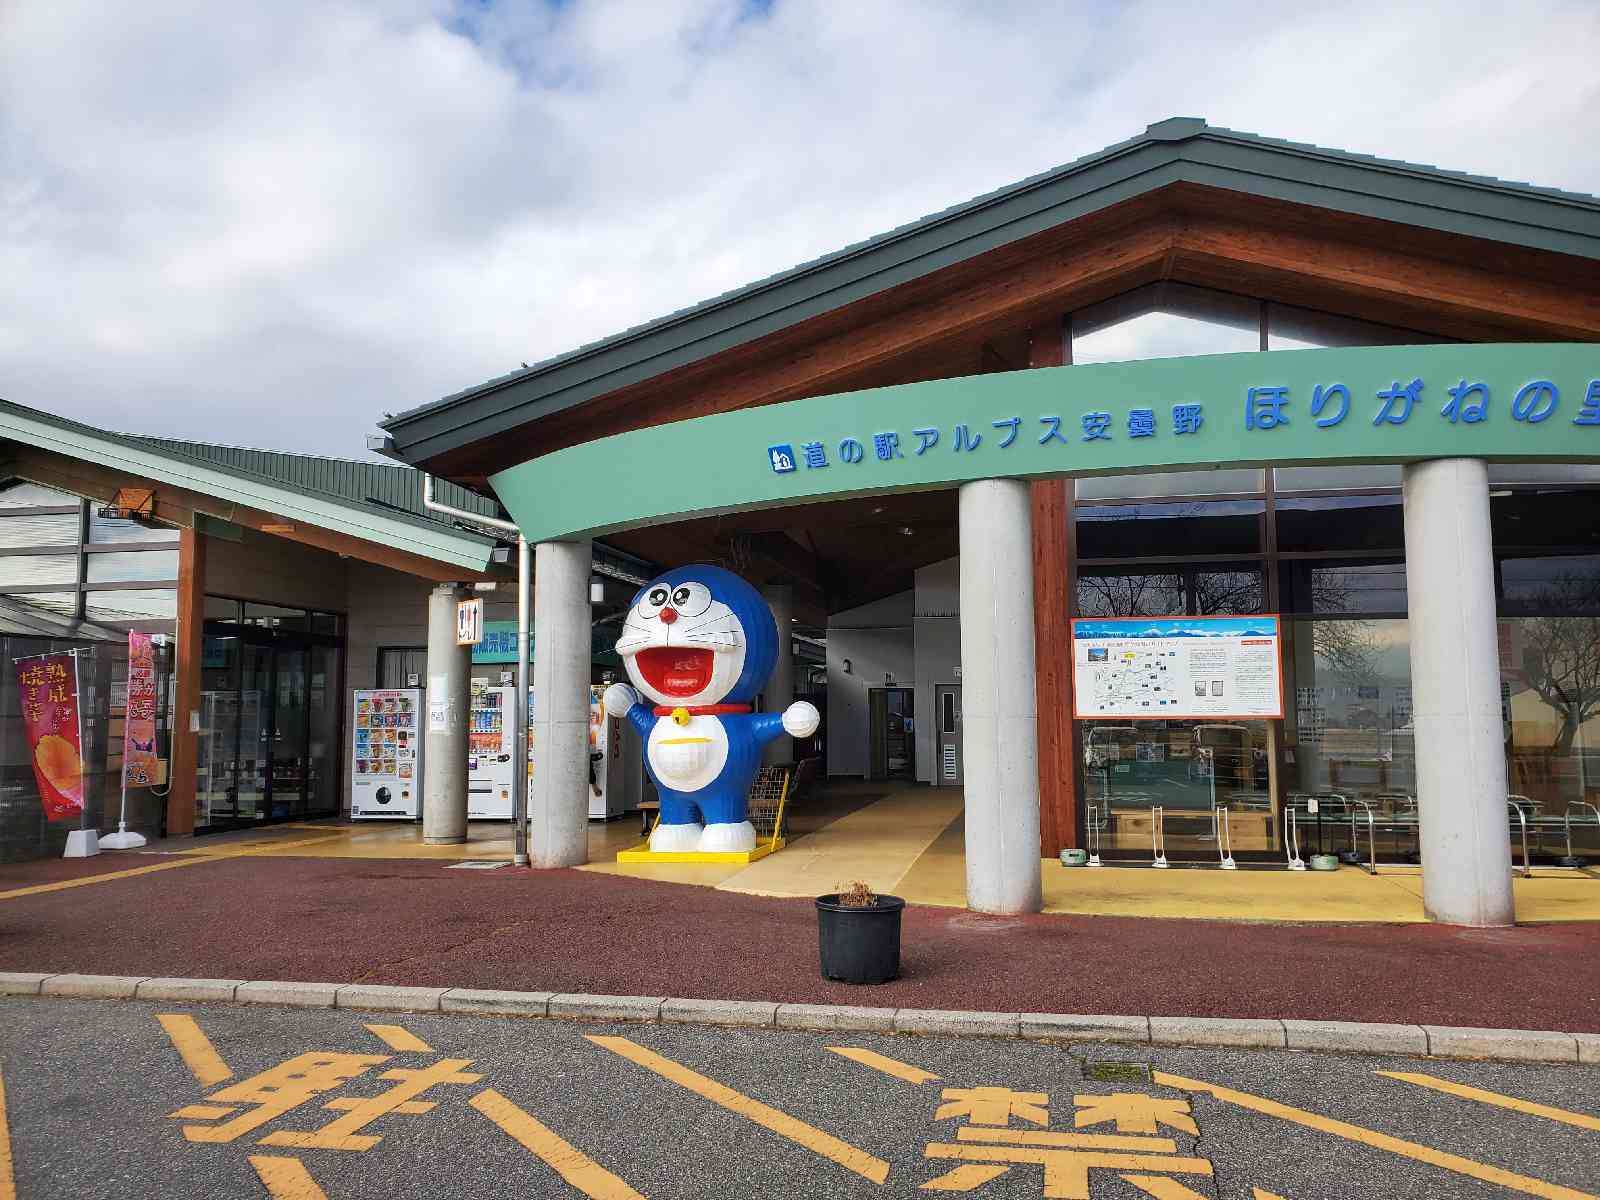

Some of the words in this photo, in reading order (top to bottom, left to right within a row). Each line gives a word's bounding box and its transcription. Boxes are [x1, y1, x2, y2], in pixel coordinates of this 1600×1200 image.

[800, 403, 1205, 470] 道の駅アルプス安曇野
